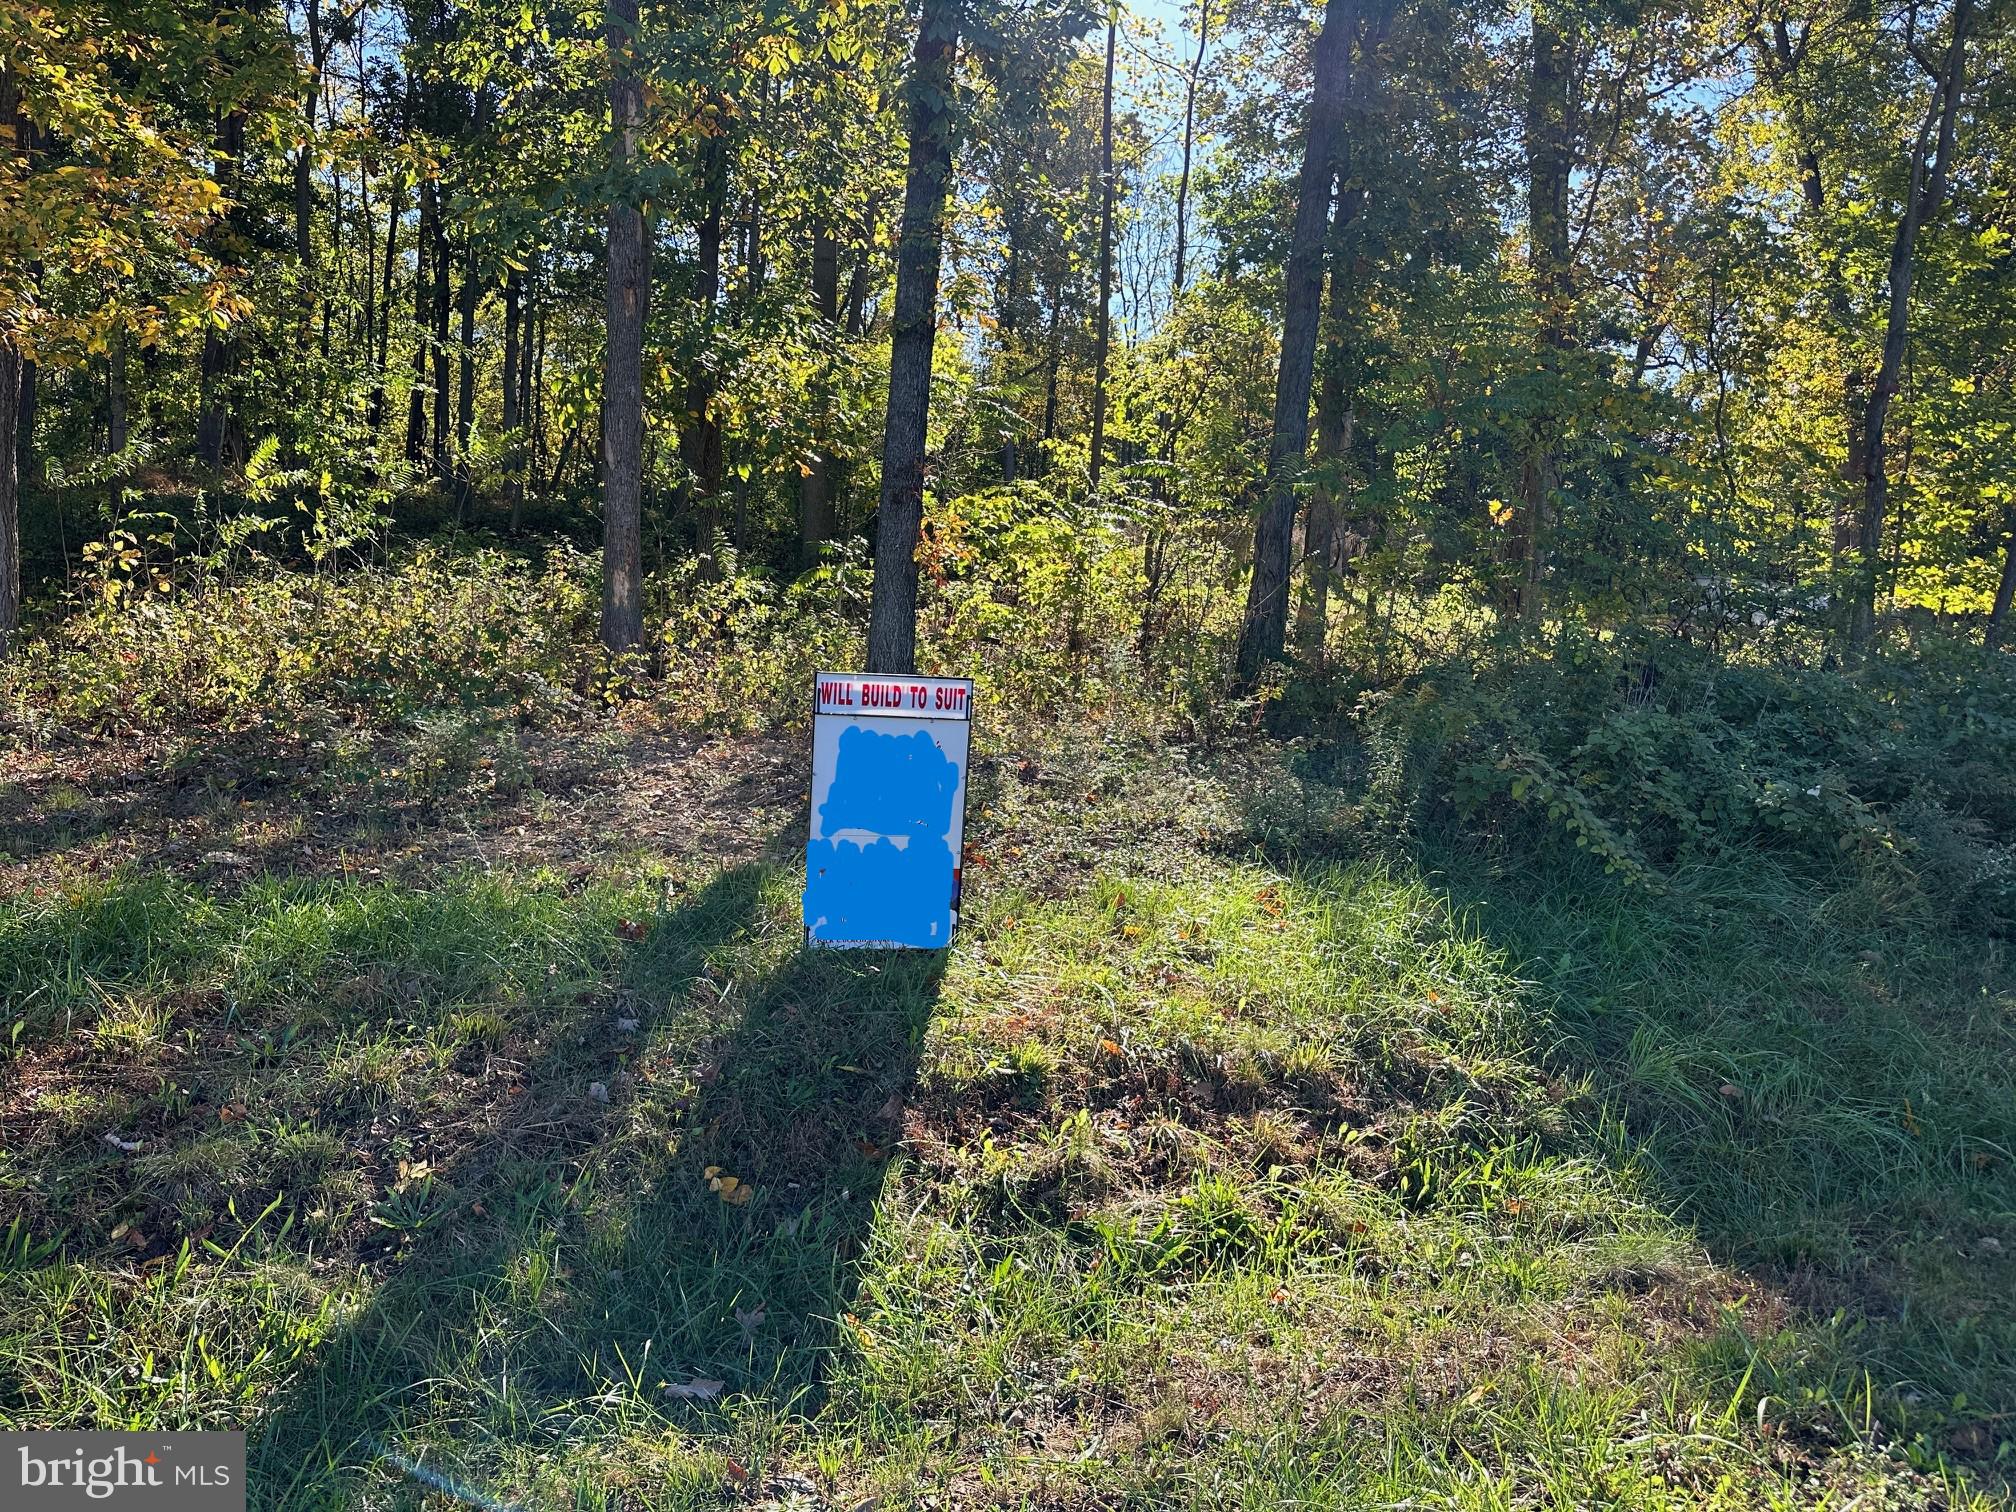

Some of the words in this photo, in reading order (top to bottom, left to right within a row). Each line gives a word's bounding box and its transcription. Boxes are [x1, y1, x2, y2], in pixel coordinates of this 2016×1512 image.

[820, 681, 853, 705] WILL
[861, 683, 902, 708] BUILD
[910, 686, 927, 709] TO
[935, 687, 966, 710] SUIT
